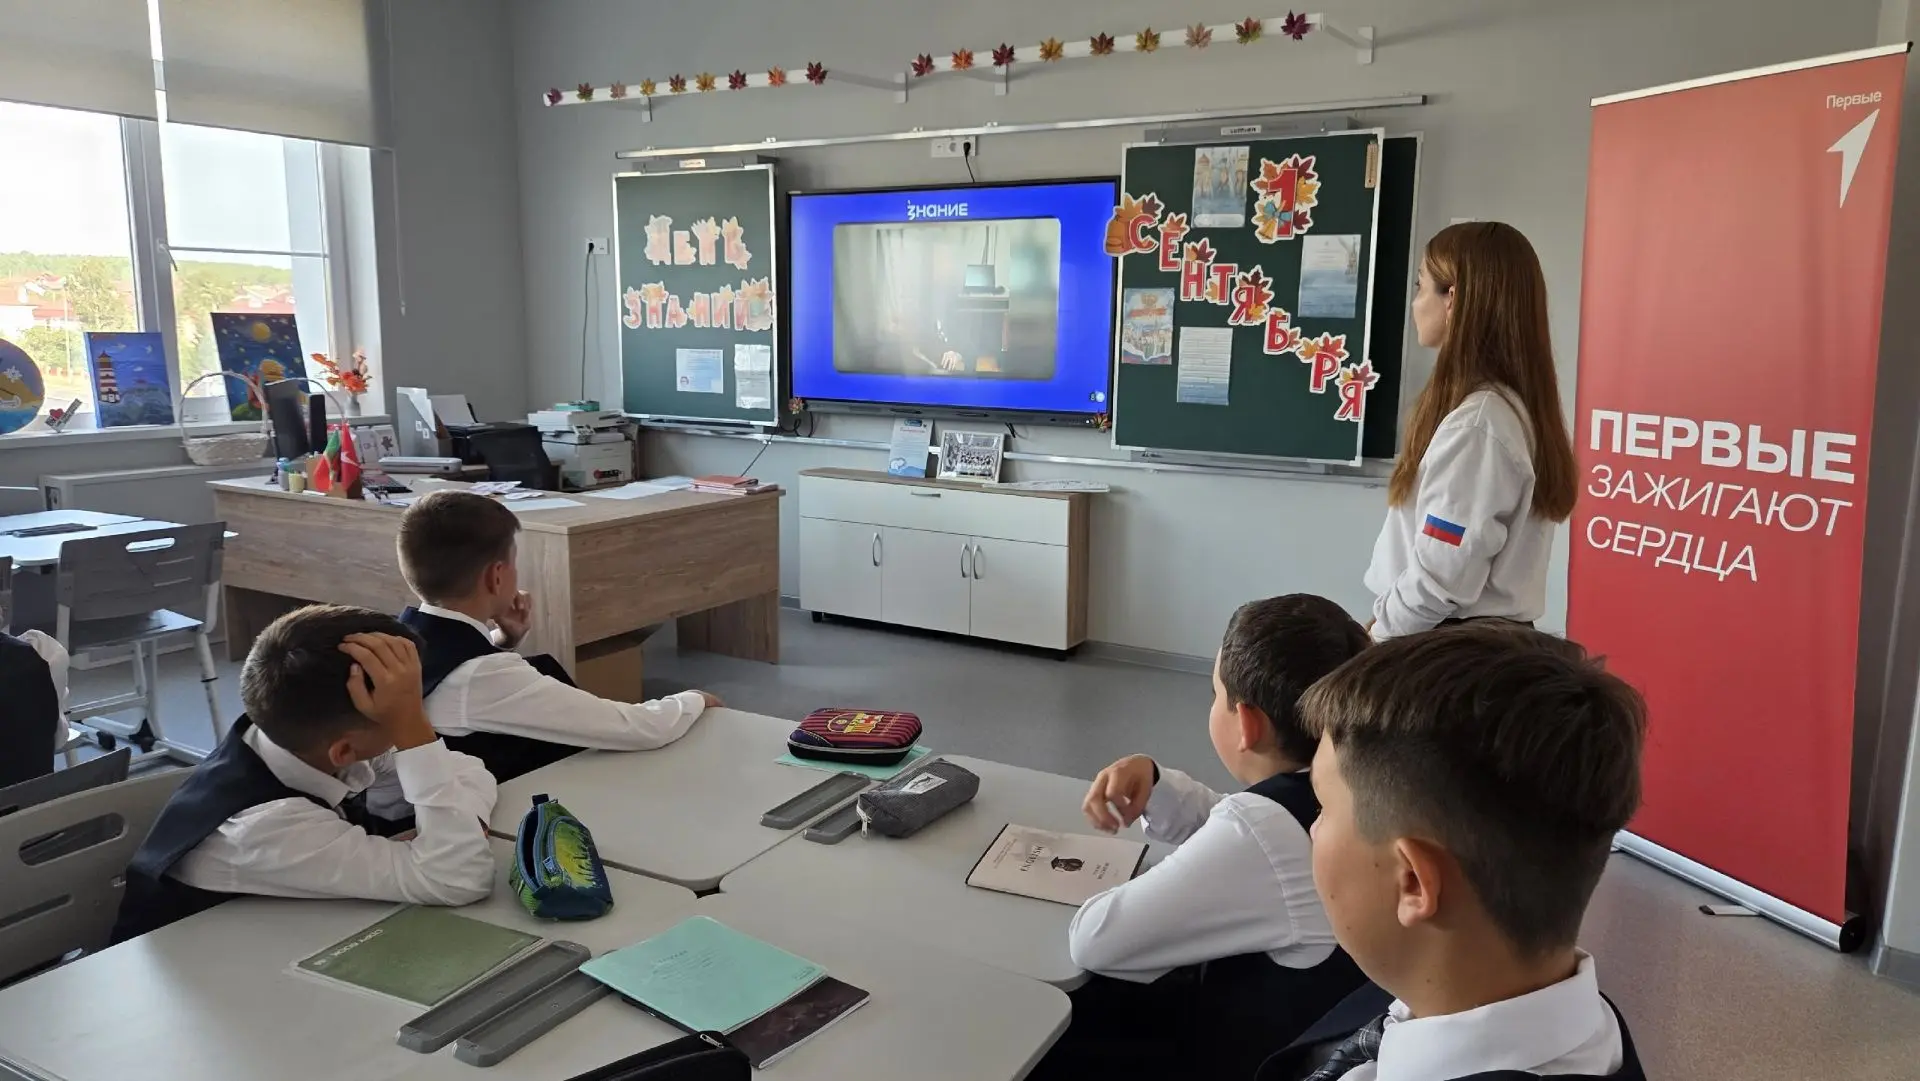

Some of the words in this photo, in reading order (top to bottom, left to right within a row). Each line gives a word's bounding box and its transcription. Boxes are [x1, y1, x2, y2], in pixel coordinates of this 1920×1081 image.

[1826, 91, 1882, 111] Первые
[1589, 409, 1857, 484] ПЕРВЫЕ
[1587, 464, 1853, 536] ЗАЖИГАЮТ
[1586, 516, 1757, 581] СЕРДЦА
